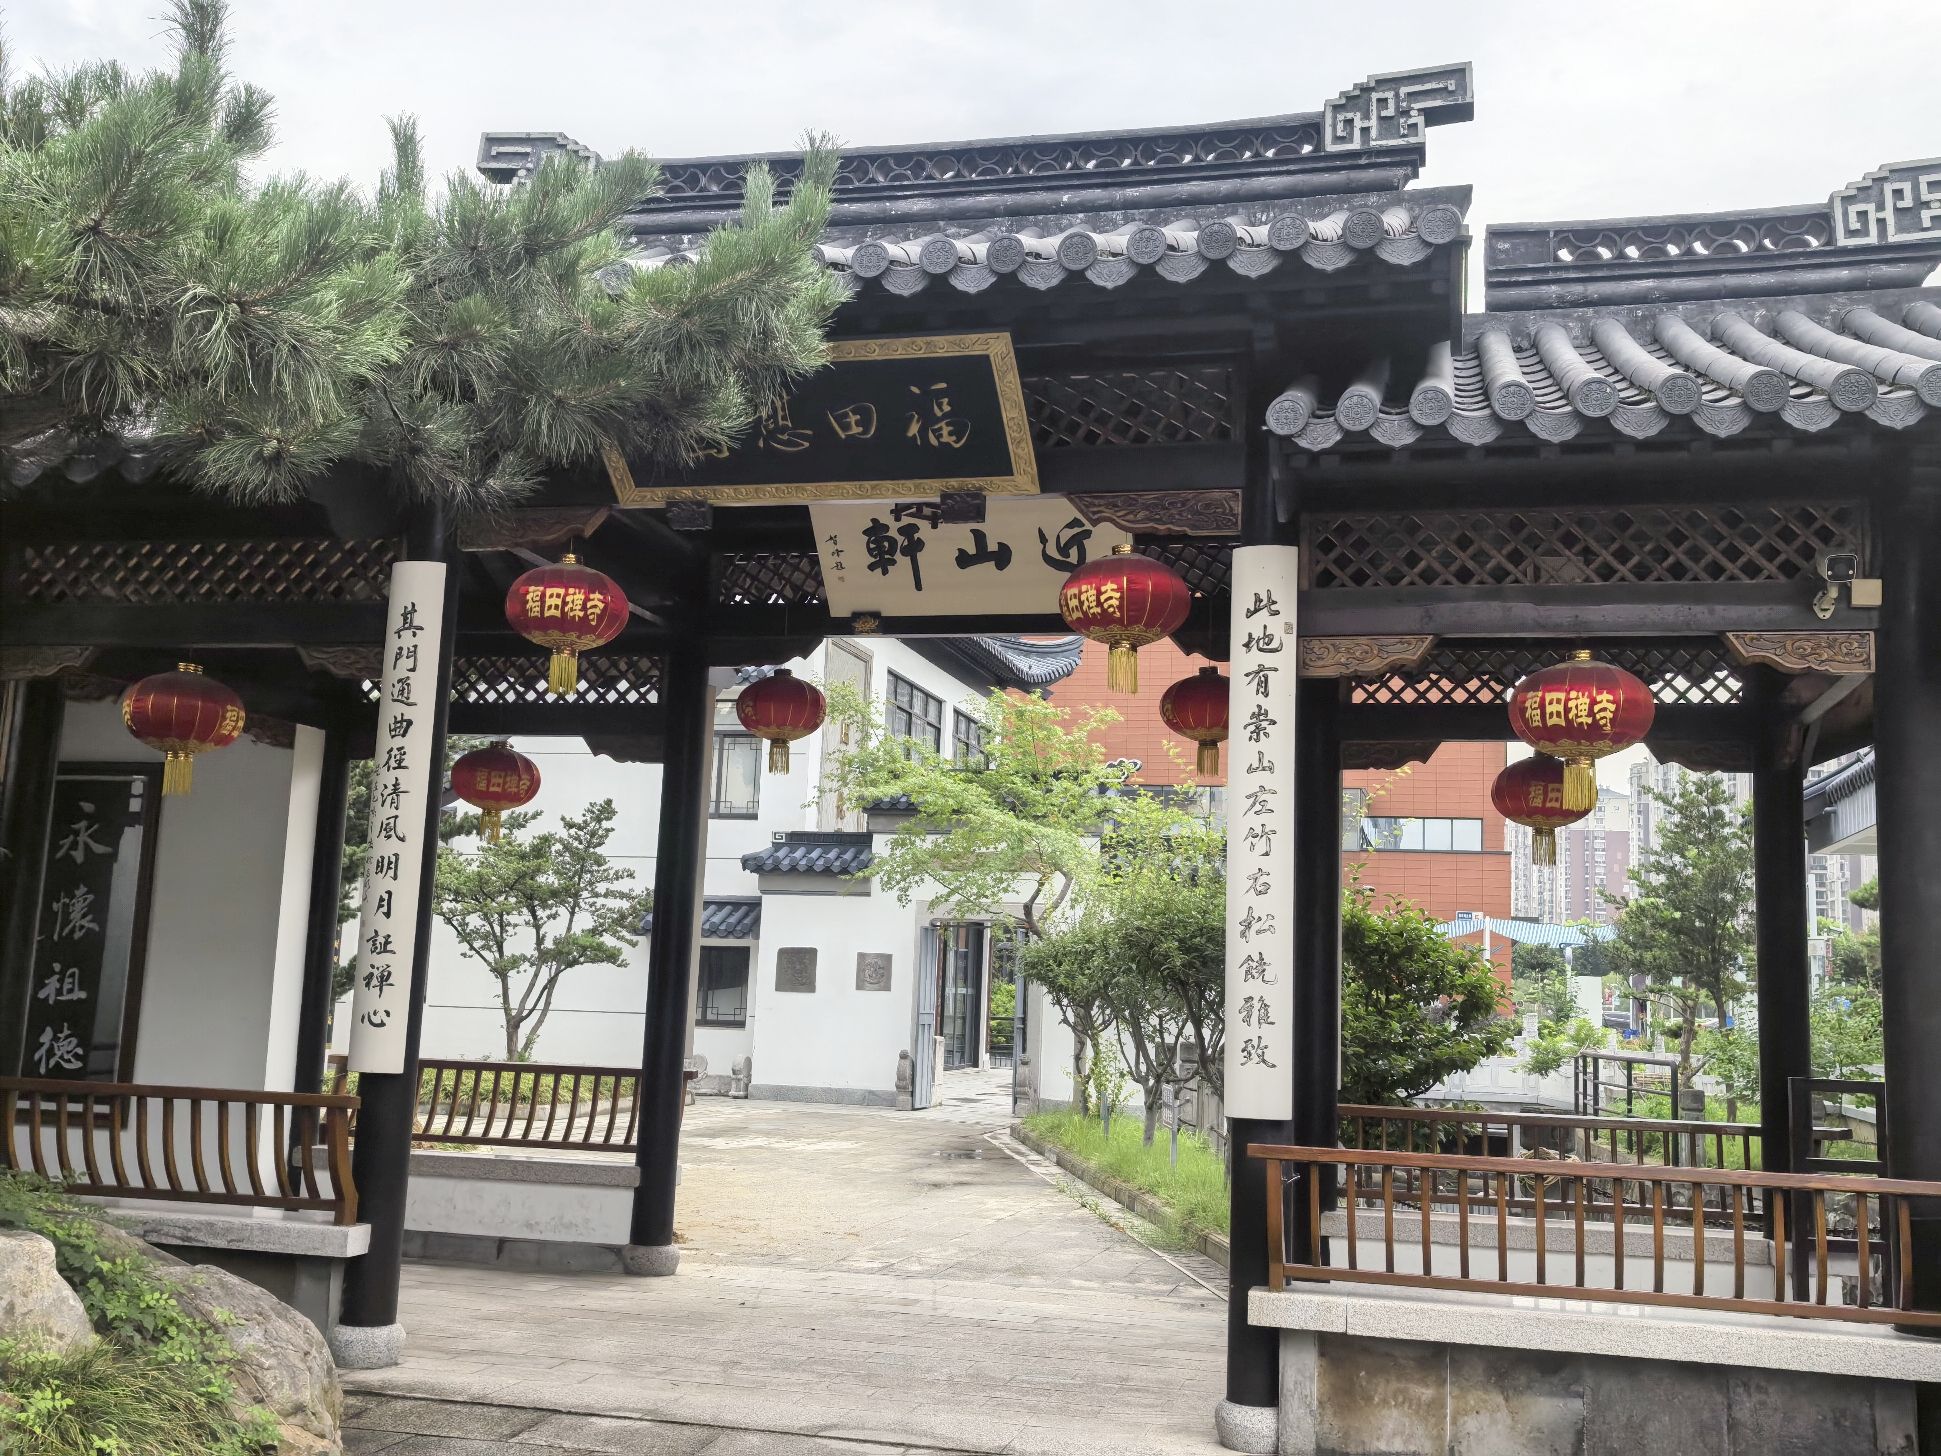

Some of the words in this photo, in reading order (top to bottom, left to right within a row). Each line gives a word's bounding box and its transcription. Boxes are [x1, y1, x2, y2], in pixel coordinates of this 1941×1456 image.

[526, 585, 606, 626] 福田禅寺
[1525, 689, 1617, 733] 福田禅寺
